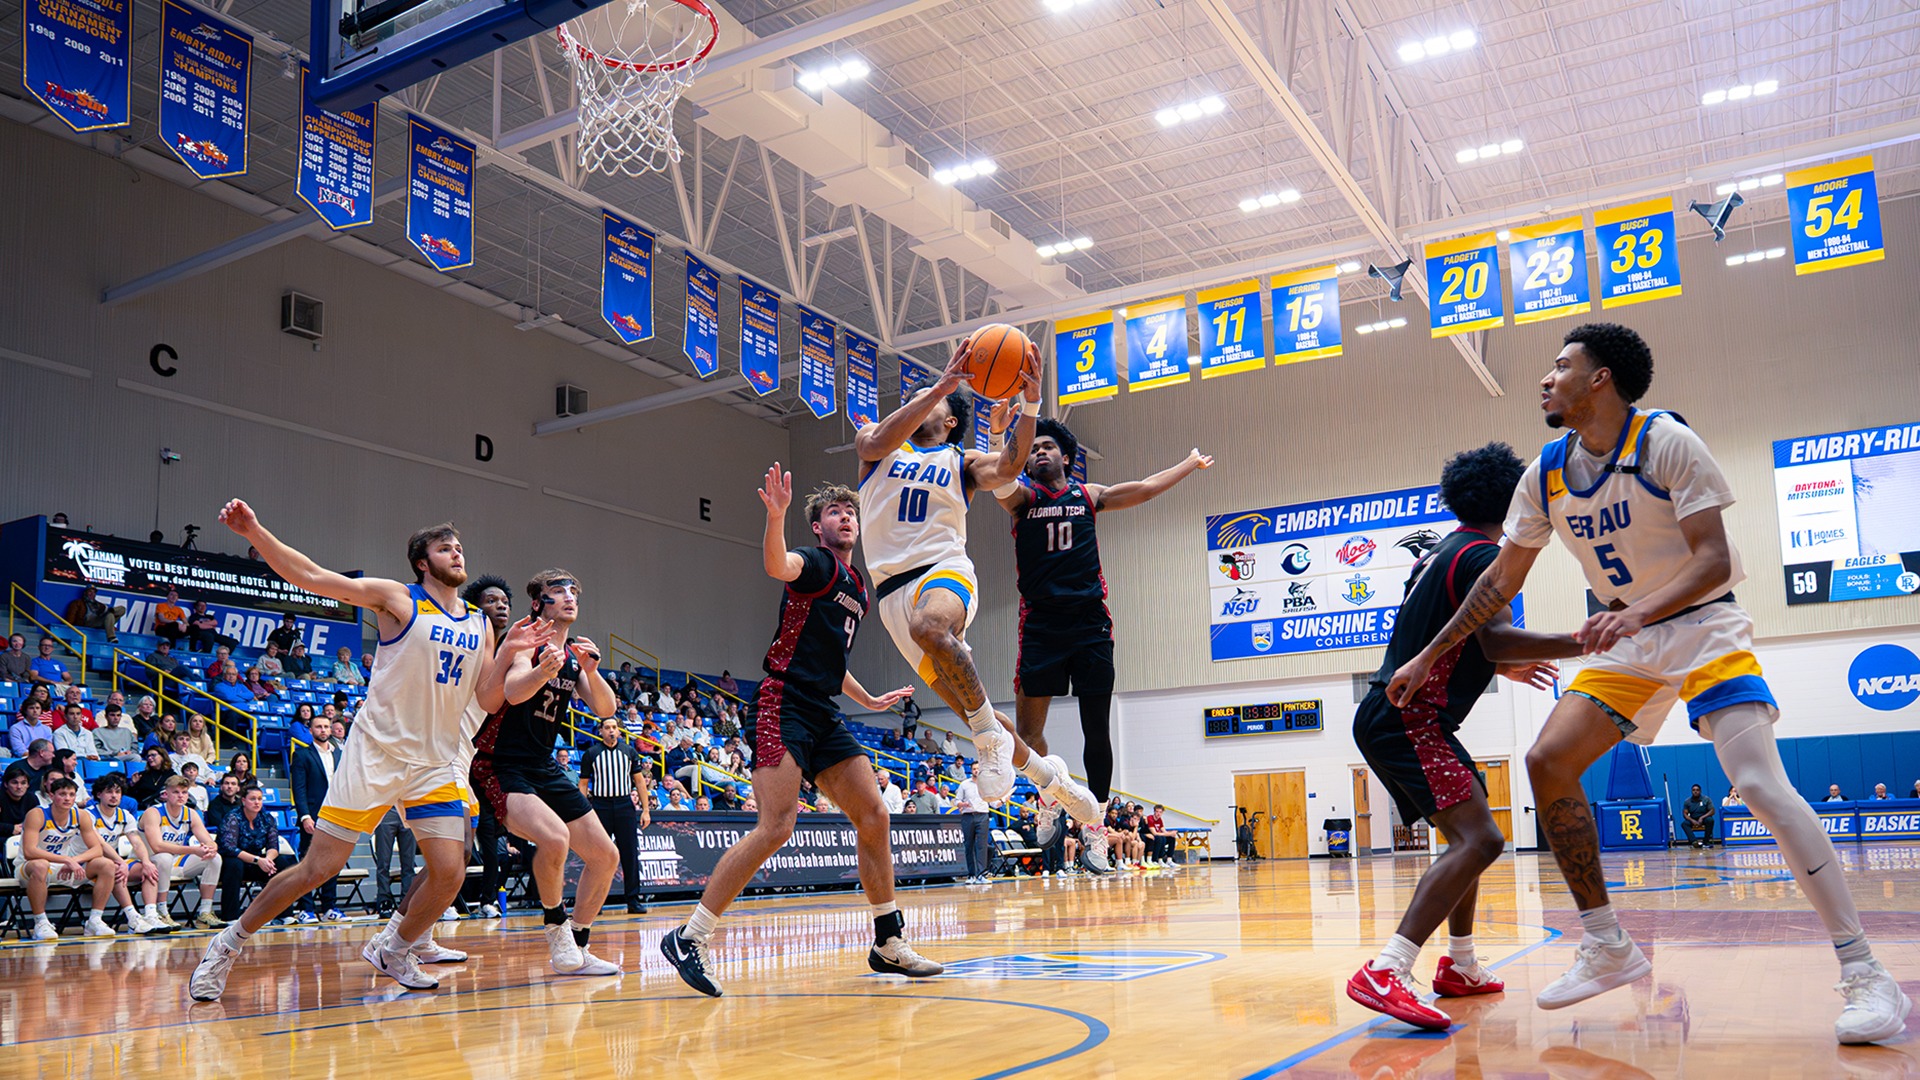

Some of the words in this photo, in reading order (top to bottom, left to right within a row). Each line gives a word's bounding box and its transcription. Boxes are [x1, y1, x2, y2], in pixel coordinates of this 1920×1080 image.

[35, 0, 122, 38] OURNAMENT
[38, 5, 116, 44] CHAMPIONS
[64, 37, 91, 54] 2009
[99, 51, 123, 66] 2011
[169, 27, 243, 70] EMBRY-RIDDLE
[174, 58, 238, 94] CHAMPIONS
[76, 90, 108, 115] Sun
[194, 82, 215, 98] 2003
[193, 103, 214, 118] 2011
[221, 105, 243, 120] 2007
[304, 115, 372, 148] CHAMPIONSHIP
[306, 123, 370, 156] APPEARANCES
[415, 144, 469, 174] EMBRY-RIDDLE
[418, 169, 465, 196] CHAMPIONS
[1813, 178, 1849, 194] MOORE
[1620, 217, 1649, 232] BUSCH
[1804, 188, 1863, 238] 54
[1536, 237, 1556, 248] MAS
[1611, 228, 1663, 274] 33
[1807, 248, 1828, 260] MEN'S
[1829, 240, 1870, 256] BASKETBALL
[1443, 250, 1480, 265] PADGETT
[1523, 246, 1574, 291] 23
[1288, 282, 1321, 296] HERRING
[1439, 261, 1489, 305] 20
[1612, 283, 1632, 295] MEN'S
[1632, 276, 1669, 291] BASKETBALL
[1214, 296, 1244, 310] PIERSON
[1286, 293, 1324, 332] 15
[1525, 299, 1543, 310] MEN'S
[1543, 293, 1579, 307] BASKETBALL
[1213, 307, 1246, 346] 11
[1441, 313, 1458, 325] MEN'S
[1459, 308, 1492, 321] BASKETBALL
[1072, 327, 1098, 339] FAGLEY
[1146, 324, 1168, 359] 4
[1295, 339, 1320, 350] BASEBALL
[149, 343, 179, 377] C
[1076, 339, 1096, 373] 3
[1210, 355, 1225, 365] MEN'S
[1226, 350, 1255, 362] BASKETBALL
[1161, 365, 1179, 375] SOCCER
[1082, 377, 1109, 389] BASKETBALL
[475, 433, 494, 462] D
[887, 460, 952, 488] ERAU
[1795, 480, 1836, 492] DAYTONA
[898, 486, 930, 523] 10
[1787, 487, 1845, 501] MITSUBISHI
[700, 497, 712, 522] E
[1026, 506, 1063, 519] FLORIDA
[1065, 505, 1086, 516] TECH
[1275, 494, 1420, 535] EMBRY-RIDDLE
[1565, 500, 1632, 540] ERAU
[1046, 521, 1073, 552] 10
[1814, 528, 1845, 540] HOMES
[88, 550, 124, 565] BAHAMA
[1296, 550, 1312, 563] EC
[1335, 538, 1377, 564] Mocs
[1845, 555, 1887, 568] EAGLES
[88, 566, 125, 583] HOUSE
[128, 558, 162, 571] VOTED
[164, 563, 188, 576] BEST
[191, 568, 238, 583] BOUTIQUE
[240, 576, 268, 588] HOTEL
[270, 580, 281, 590] IN
[1593, 543, 1633, 587] 5
[146, 573, 278, 599] www.daytonabahamahouse.com
[1792, 571, 1818, 595] 59
[1221, 599, 1260, 616] NSU
[1282, 606, 1317, 614] SAILFISH
[1283, 595, 1315, 608] PBA
[429, 624, 479, 651] ERAU
[844, 615, 856, 648] 4
[1281, 611, 1377, 640] SUNSHINE
[435, 650, 465, 687] 34
[1856, 674, 1920, 697] NCAA
[1211, 707, 1235, 717] EAGLES
[1284, 701, 1316, 712] PANTHERS
[639, 836, 675, 850] BAHAMA
[697, 831, 740, 848] VOTED
[892, 830, 935, 845] DAYTONA
[640, 860, 680, 880] HOUSE
[901, 848, 957, 864] 800-571-2001
